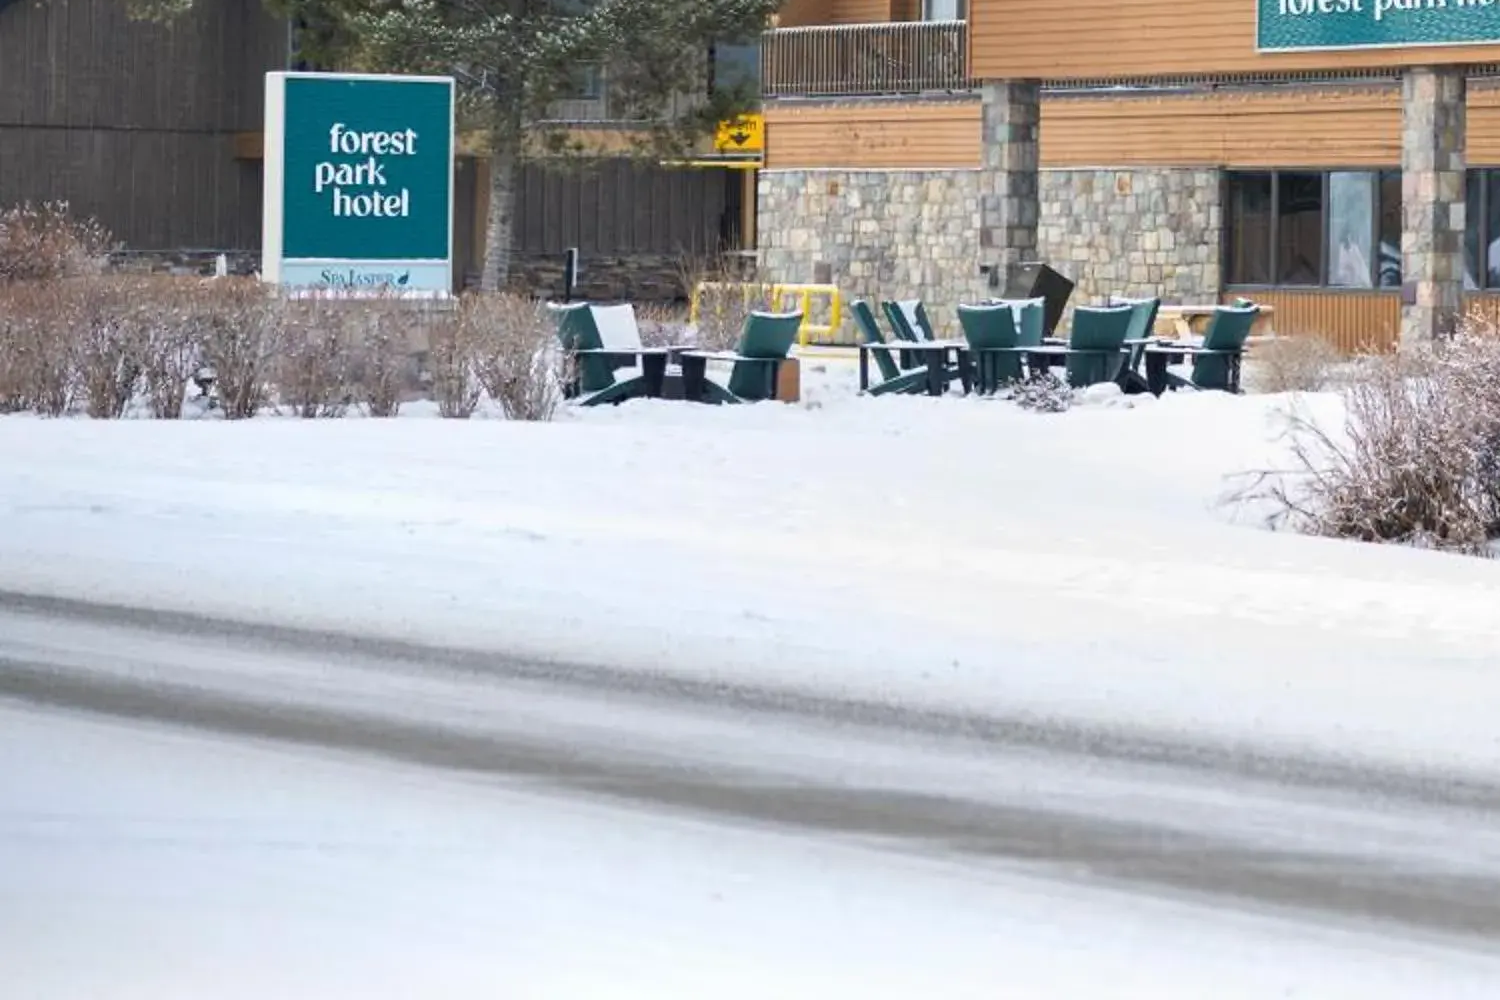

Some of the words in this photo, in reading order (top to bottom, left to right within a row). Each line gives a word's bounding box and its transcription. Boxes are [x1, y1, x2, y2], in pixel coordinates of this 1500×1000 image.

[329, 122, 418, 155] forest
[315, 156, 387, 193] park
[333, 187, 409, 217] hotel
